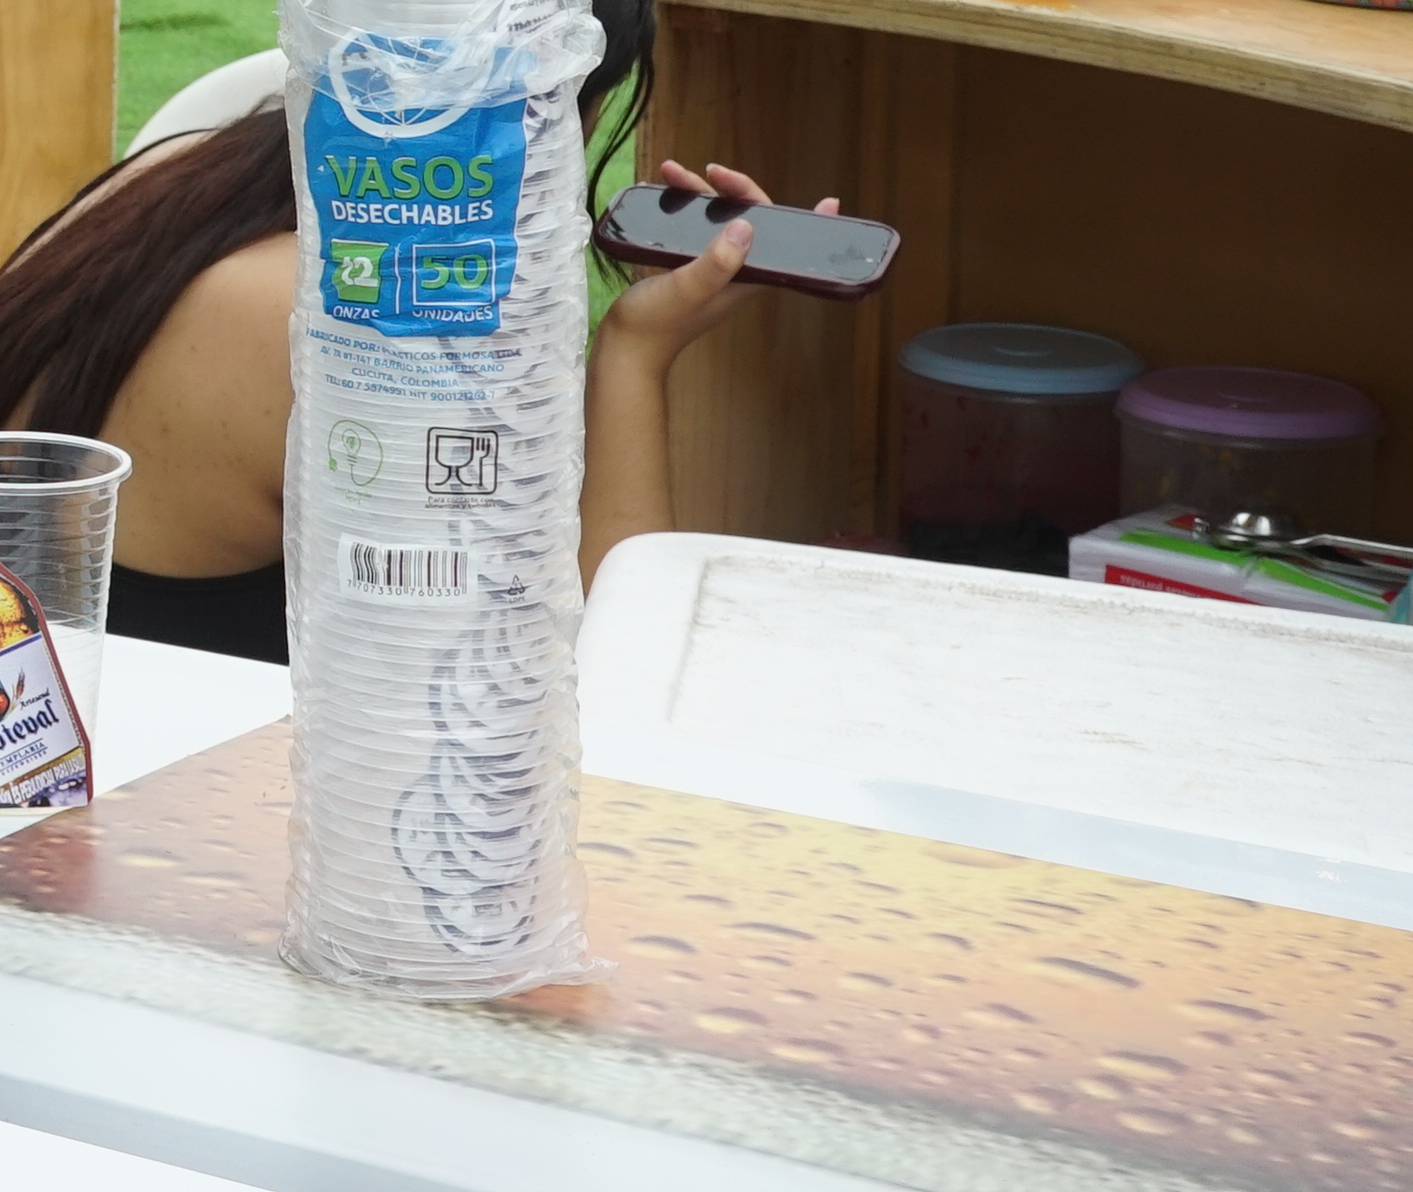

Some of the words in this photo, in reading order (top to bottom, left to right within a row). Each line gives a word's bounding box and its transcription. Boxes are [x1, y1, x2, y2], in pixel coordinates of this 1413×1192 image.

[325, 155, 494, 201] VASOS
[331, 199, 494, 226] DESECHABLES
[420, 253, 489, 290] 50
[333, 305, 381, 319] ONZAS
[411, 305, 494, 324] UNIDADES
[306, 327, 351, 346] FABRICADO
[353, 340, 380, 352] POR:
[439, 349, 494, 360] FORMOSA
[415, 363, 504, 375] PANAMERICANO
[400, 376, 460, 388] COLOMBIA
[409, 587, 461, 597] 760330
